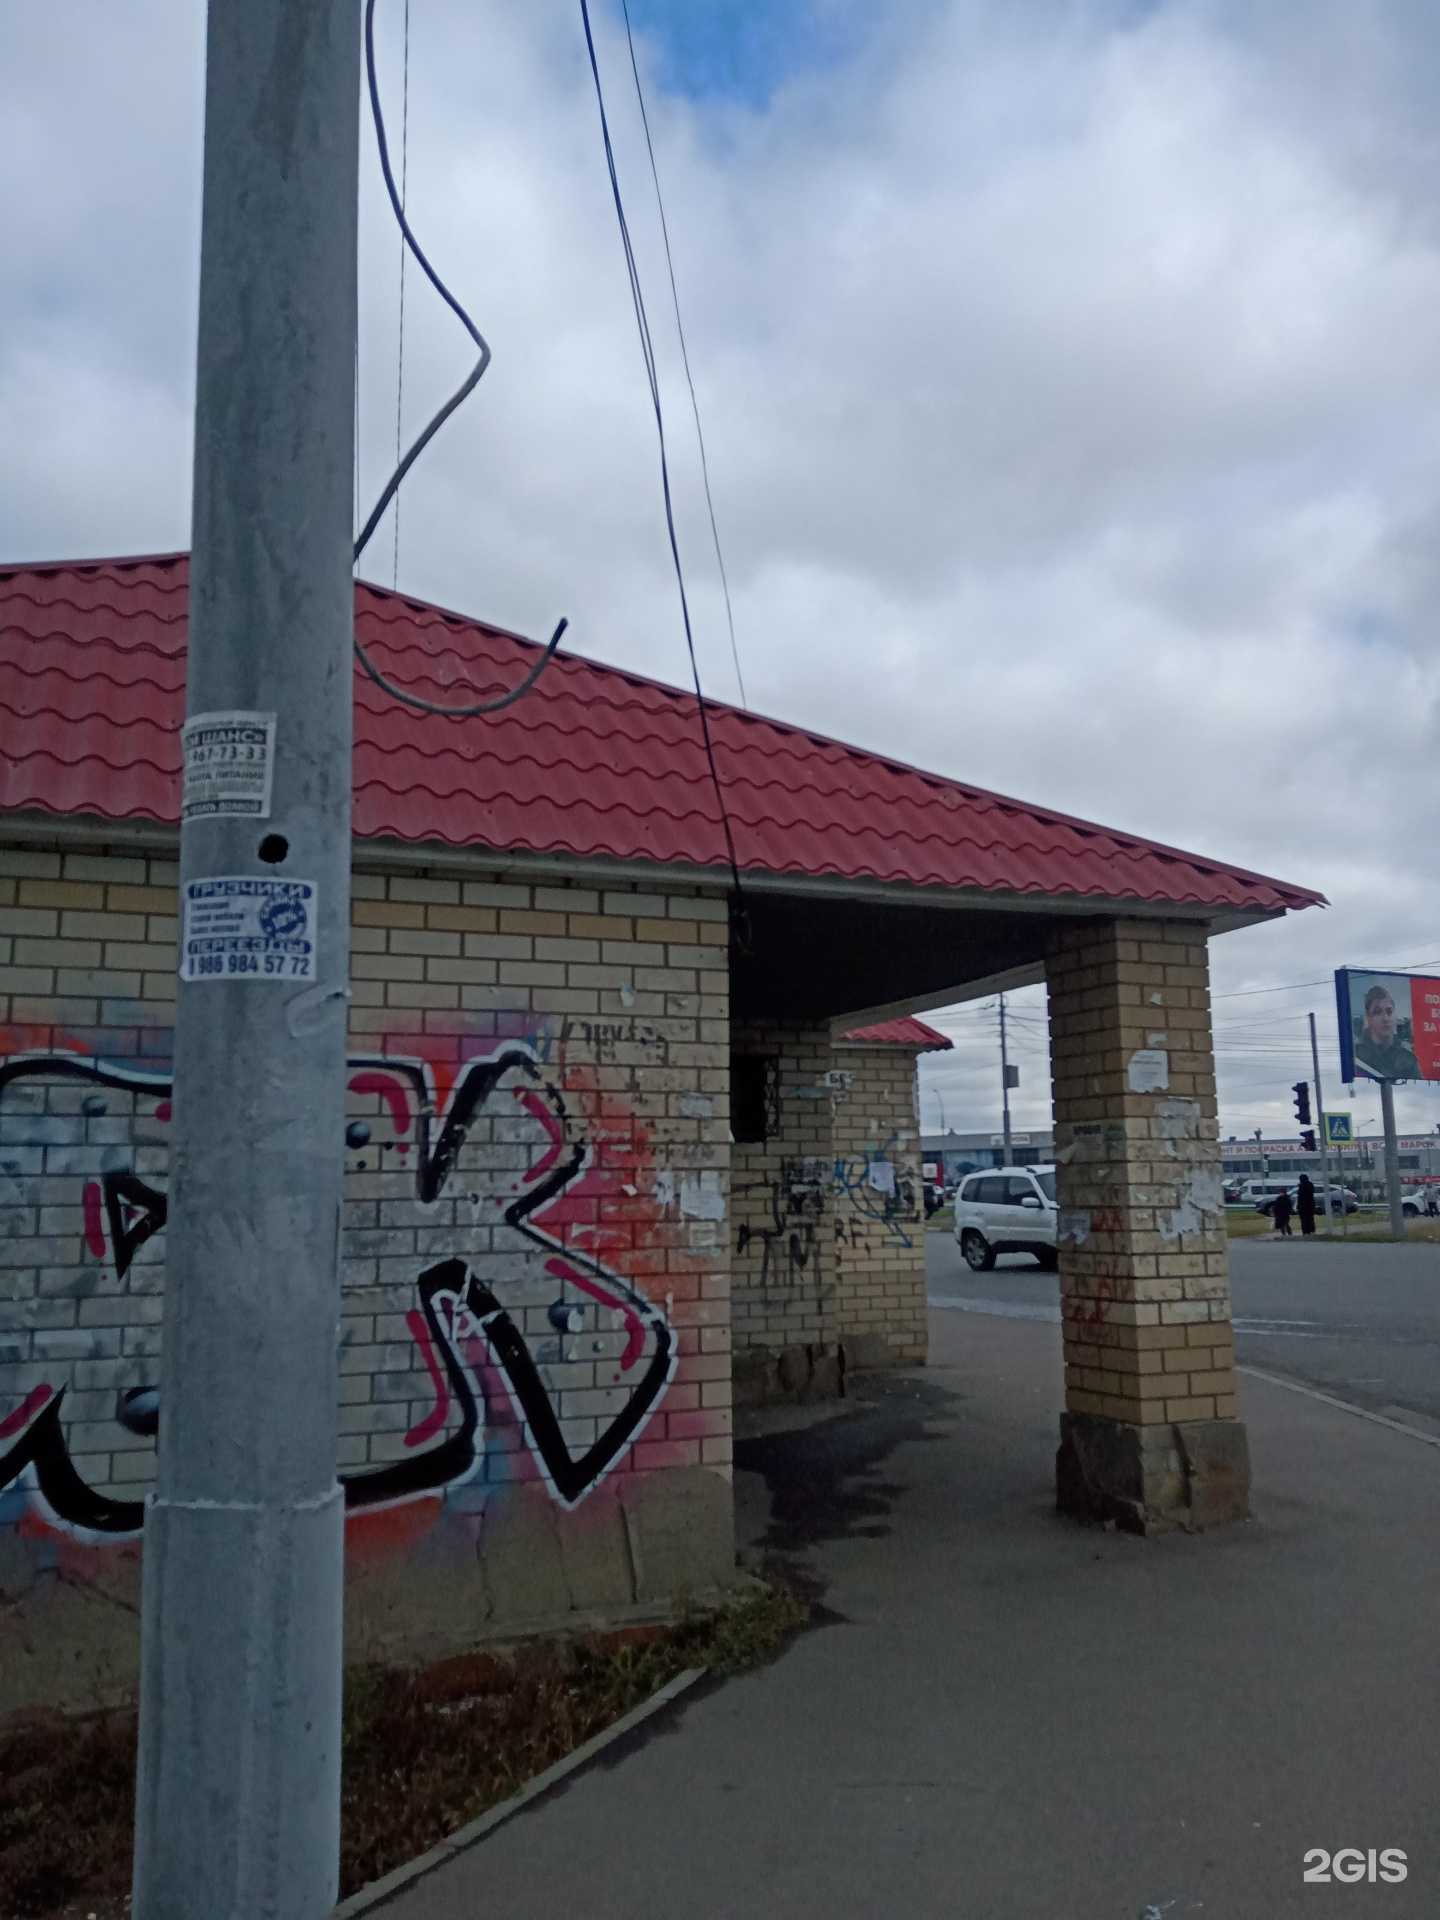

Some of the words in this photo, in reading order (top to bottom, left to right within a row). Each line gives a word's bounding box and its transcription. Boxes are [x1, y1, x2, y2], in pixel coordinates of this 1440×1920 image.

[191, 882, 304, 897] ГРУЗЧИКИ
[190, 938, 304, 953] ПЕРЕЕЗДЫ
[264, 955, 285, 973] 57
[290, 957, 310, 975] 72
